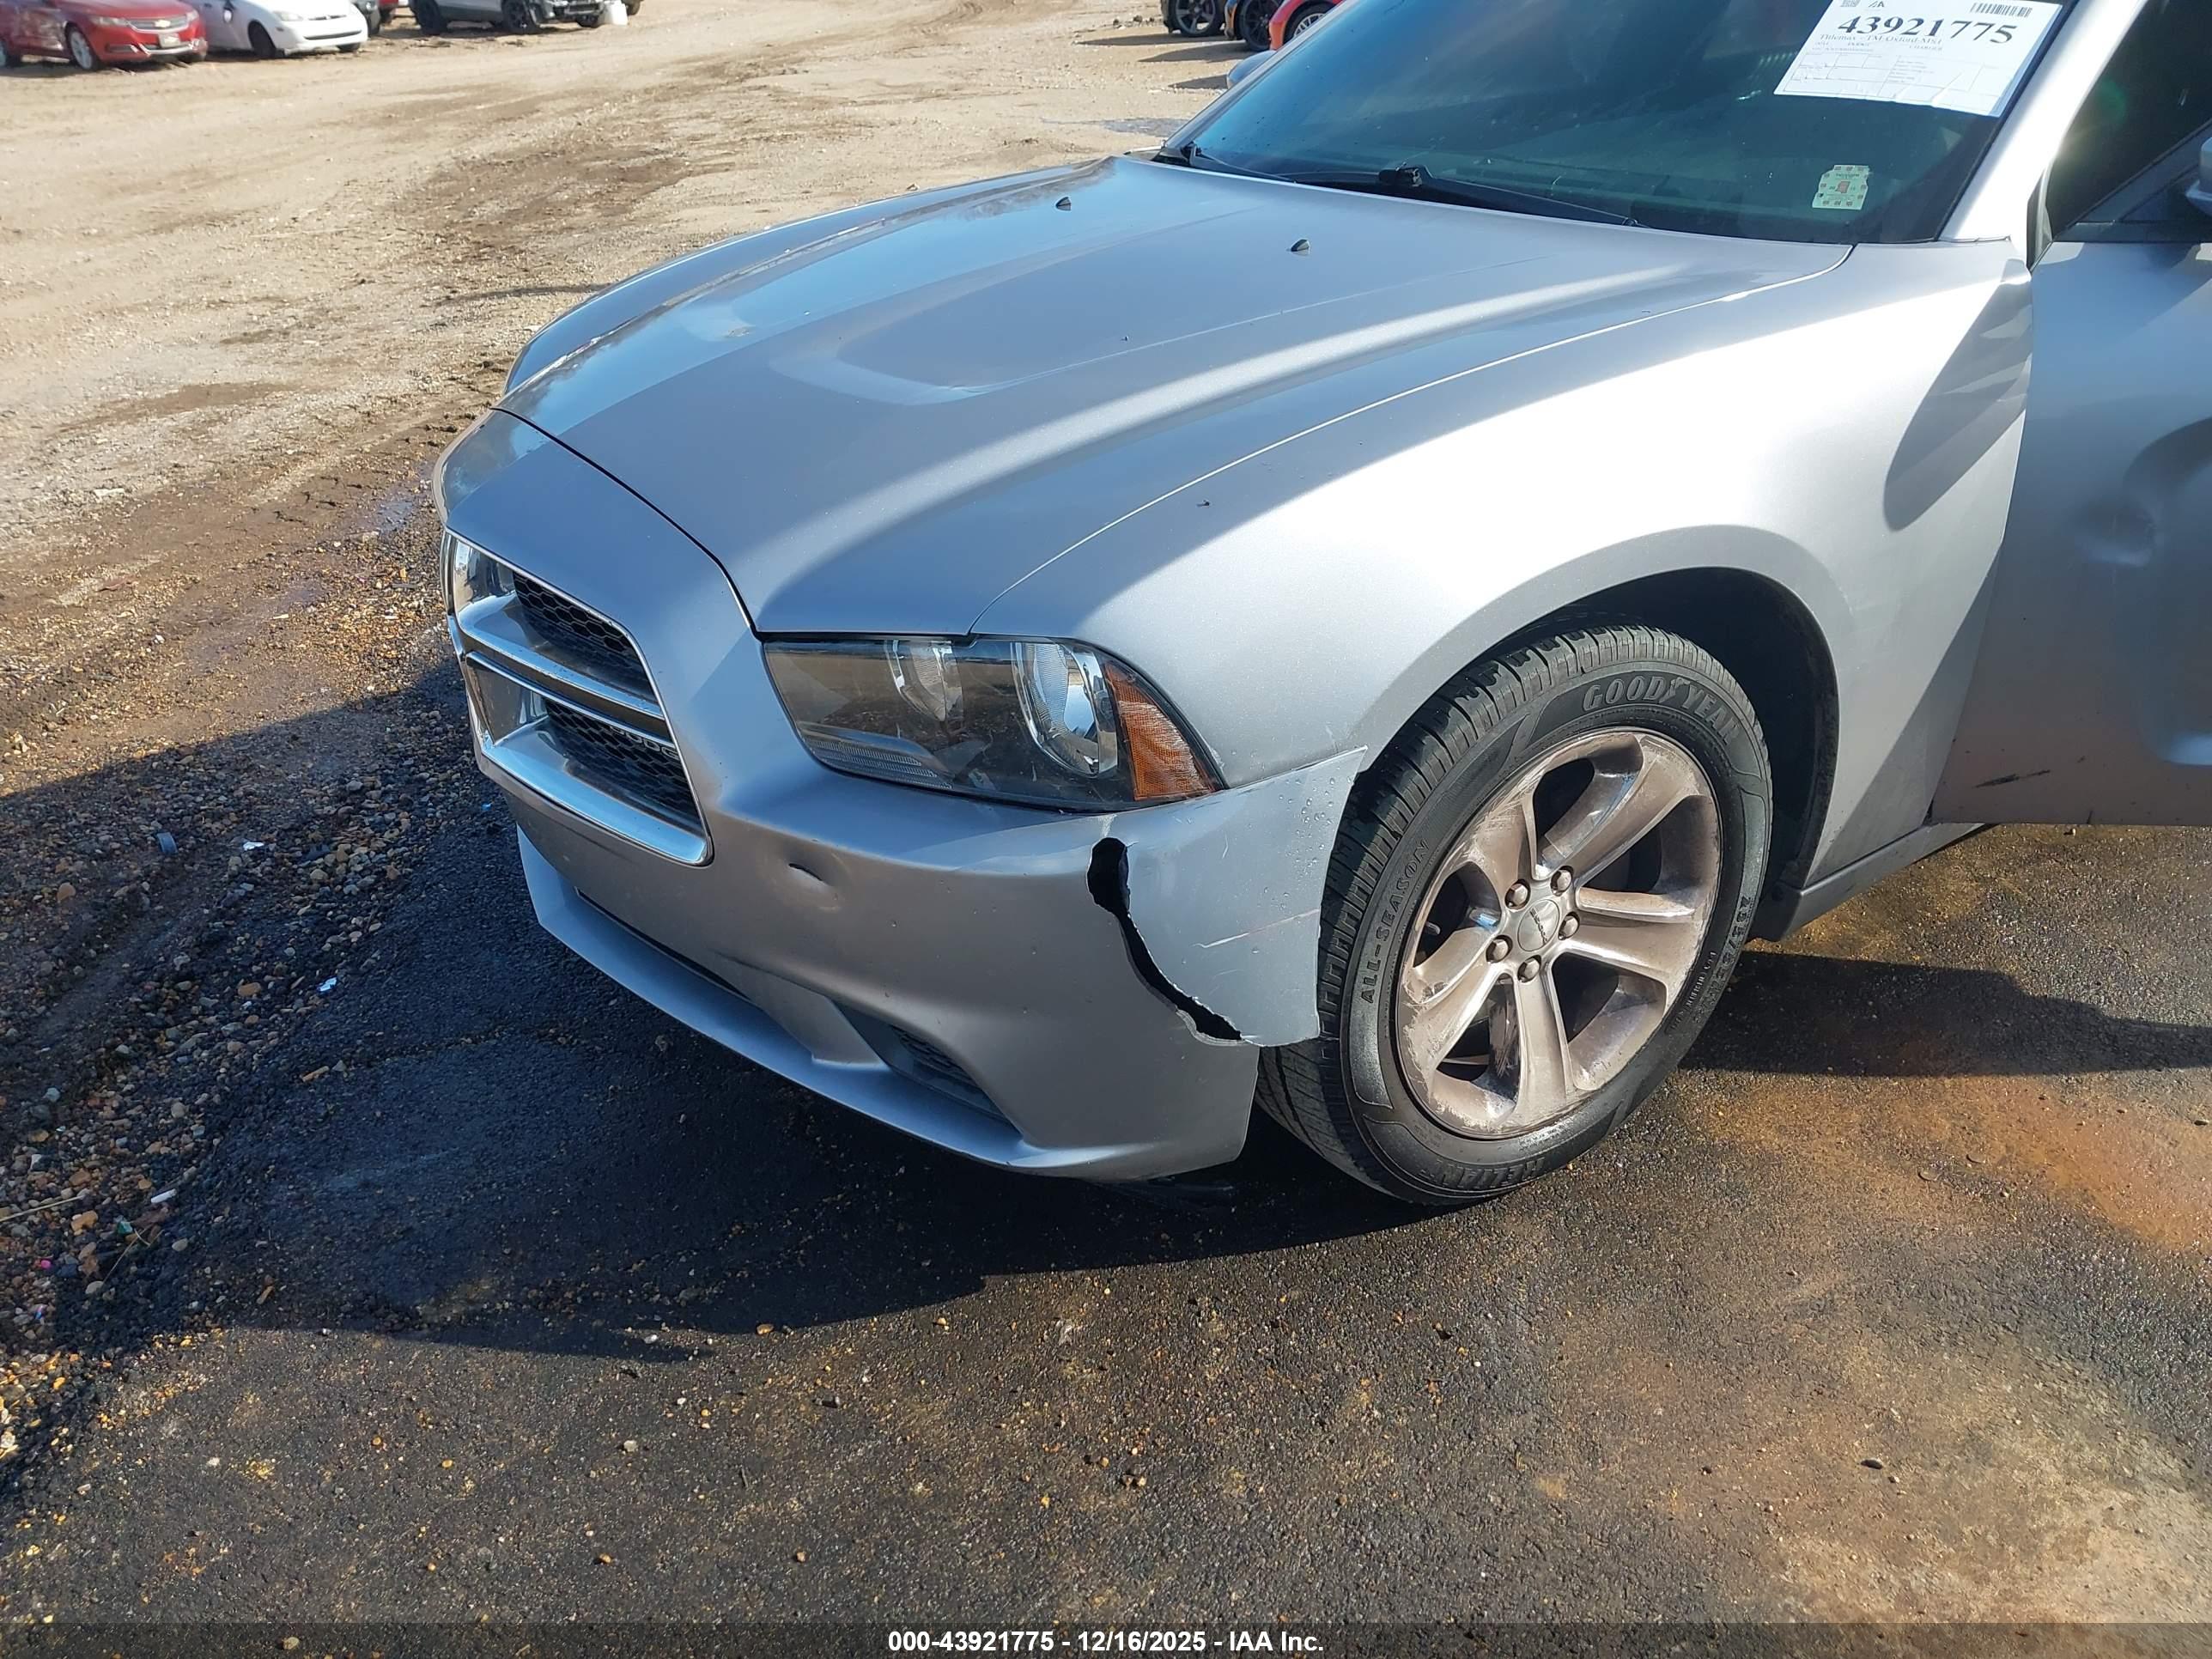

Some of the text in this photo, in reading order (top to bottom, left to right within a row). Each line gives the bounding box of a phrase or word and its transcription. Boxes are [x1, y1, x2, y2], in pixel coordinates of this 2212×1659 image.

[1838, 15, 2018, 44] 43921775
[1583, 675, 1741, 745] GOODYEAR
[1361, 839, 1430, 1004] ALL-SEASON
